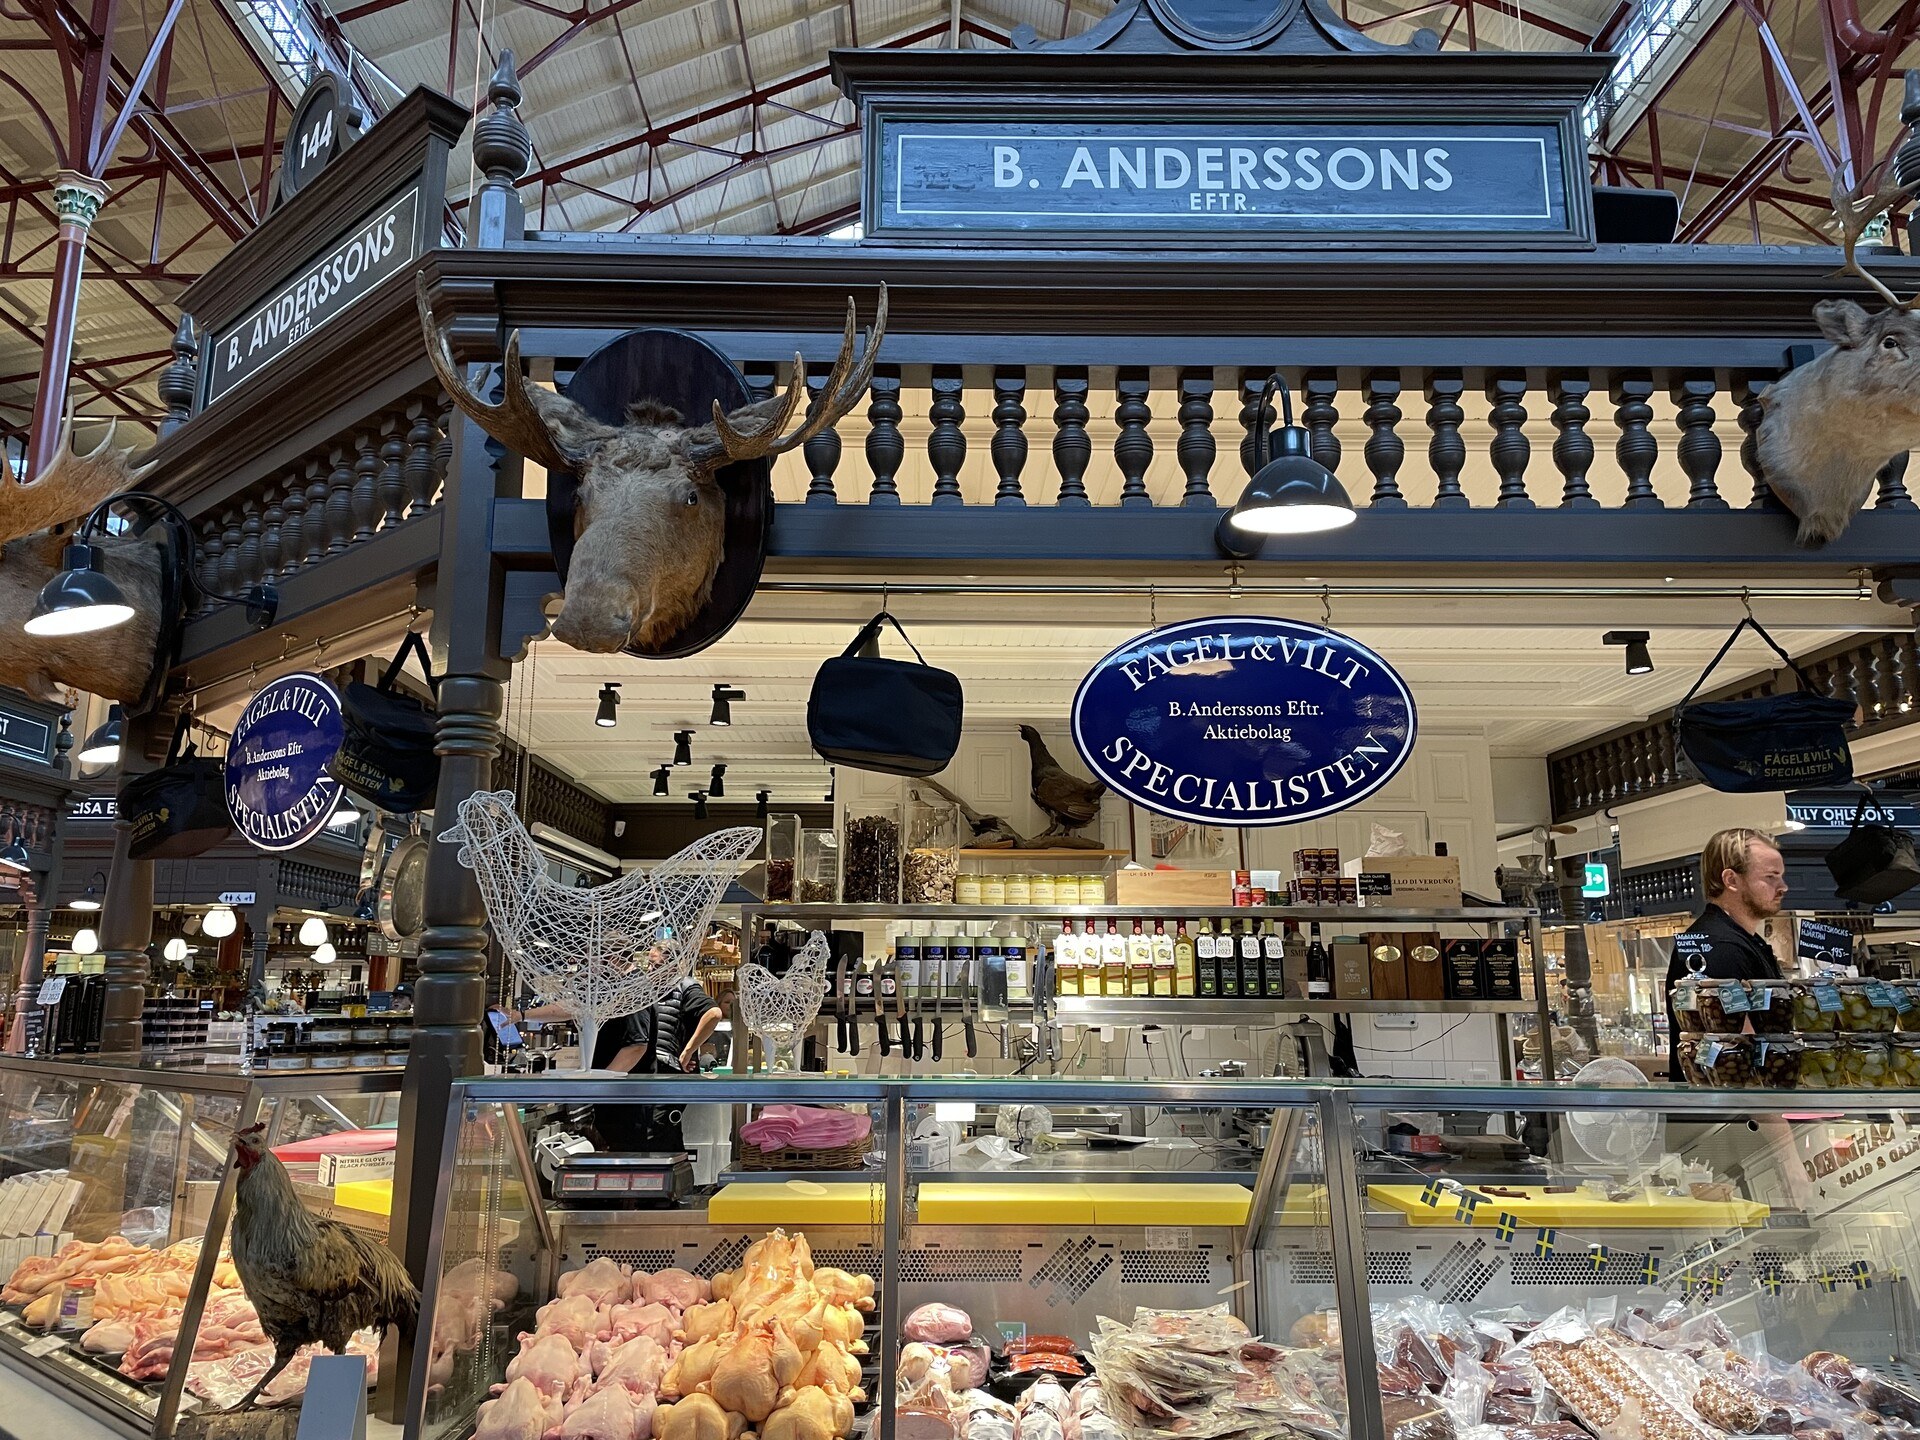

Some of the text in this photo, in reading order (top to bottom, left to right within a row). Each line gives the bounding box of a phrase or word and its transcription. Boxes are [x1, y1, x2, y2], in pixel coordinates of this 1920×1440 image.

[300, 109, 333, 169] 144
[994, 146, 1453, 191] B. ANDERSSONS
[1190, 193, 1257, 211] EFTR.
[227, 214, 396, 372] B. ANDERSSONS
[288, 316, 313, 345] EFTR.
[1287, 700, 1324, 716] Eftr.
[1203, 724, 1292, 743] Aktiebolag
[256, 764, 290, 782] Aktiebolag
[1101, 731, 1389, 811] SPECIALISTEN
[1764, 762, 1834, 777] SPECIALISTEN
[228, 762, 335, 840] SPECIALISTEN
